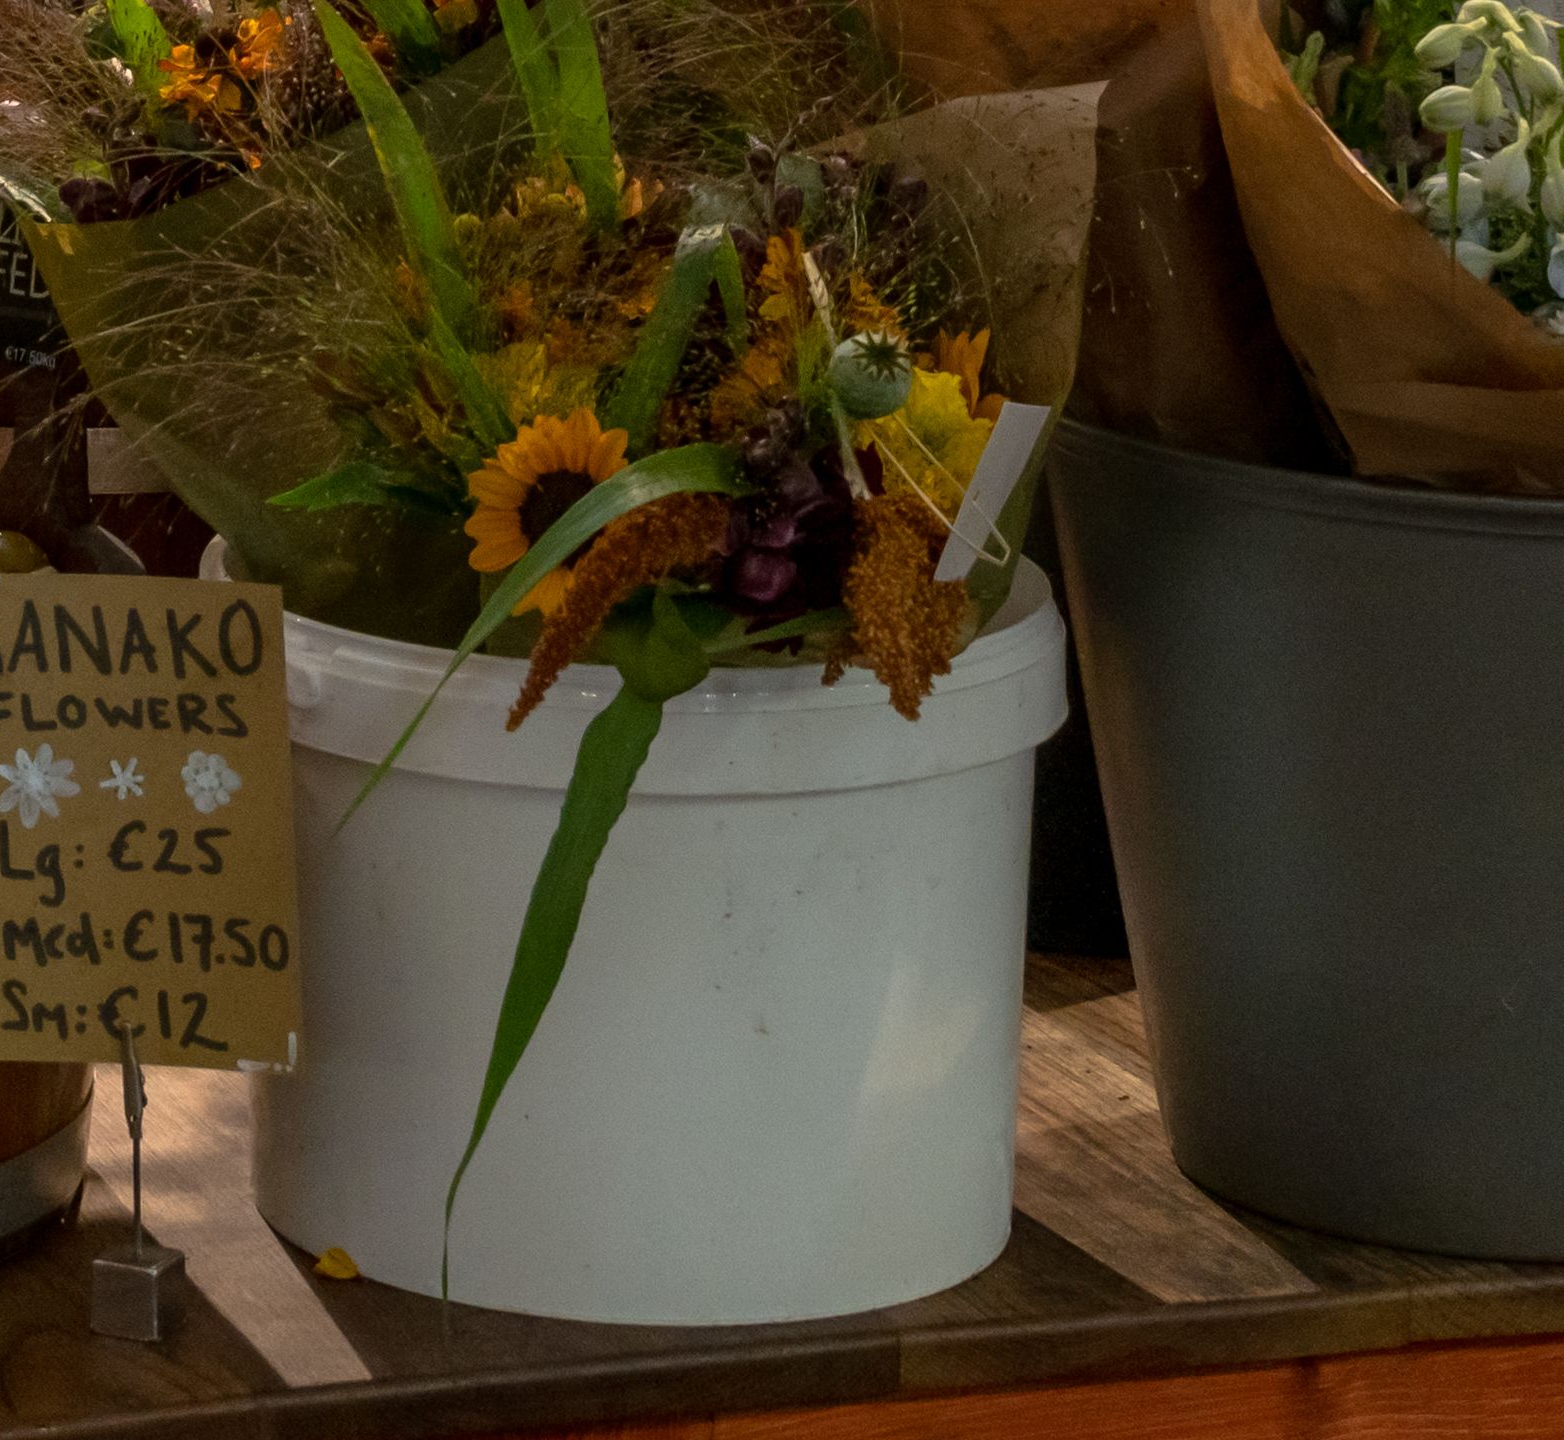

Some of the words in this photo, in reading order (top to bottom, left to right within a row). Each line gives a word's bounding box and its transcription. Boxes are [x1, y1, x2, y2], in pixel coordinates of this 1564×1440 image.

[107, 819, 232, 875] €25
[121, 908, 291, 973] €17.50
[97, 984, 229, 1052] €12
